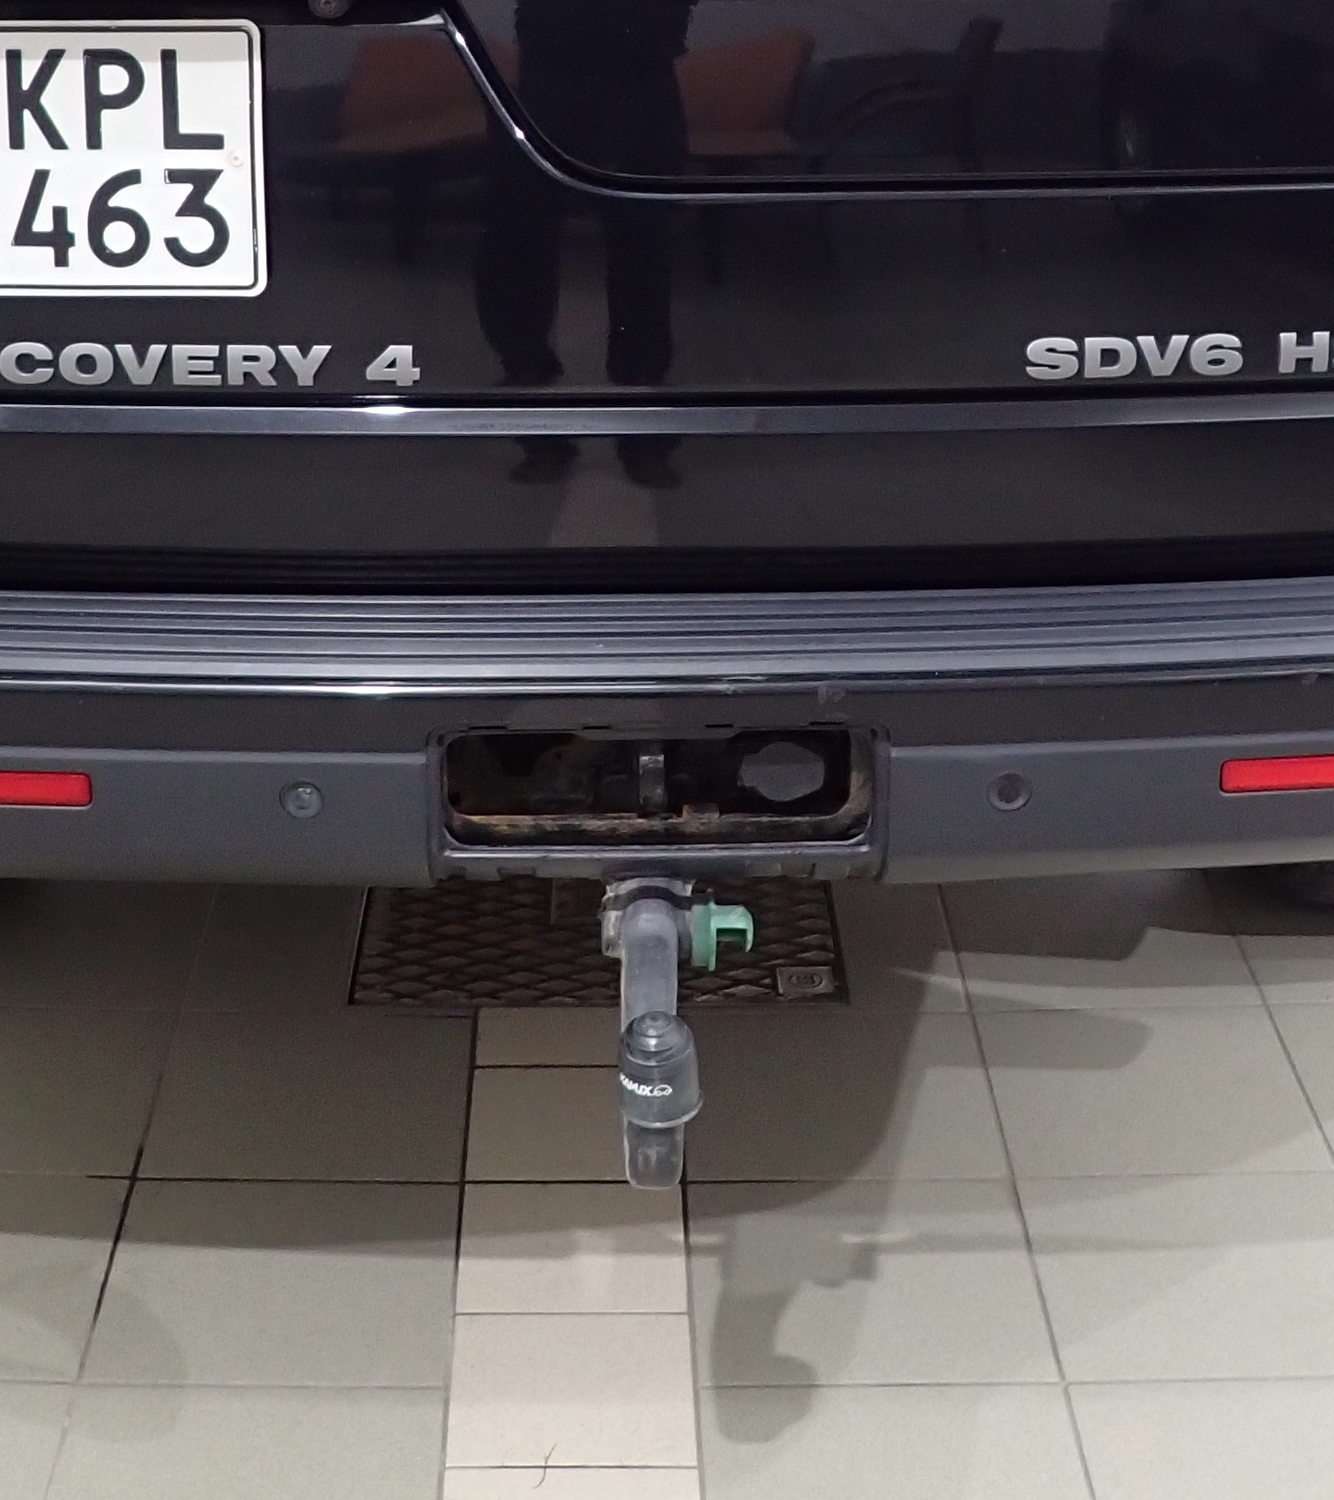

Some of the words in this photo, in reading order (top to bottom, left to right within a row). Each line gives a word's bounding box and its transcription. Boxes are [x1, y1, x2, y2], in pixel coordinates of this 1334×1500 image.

[4, 47, 225, 151] KPL
[11, 168, 232, 269] 463
[366, 344, 422, 388] 4
[1025, 332, 1244, 381] SDV6
